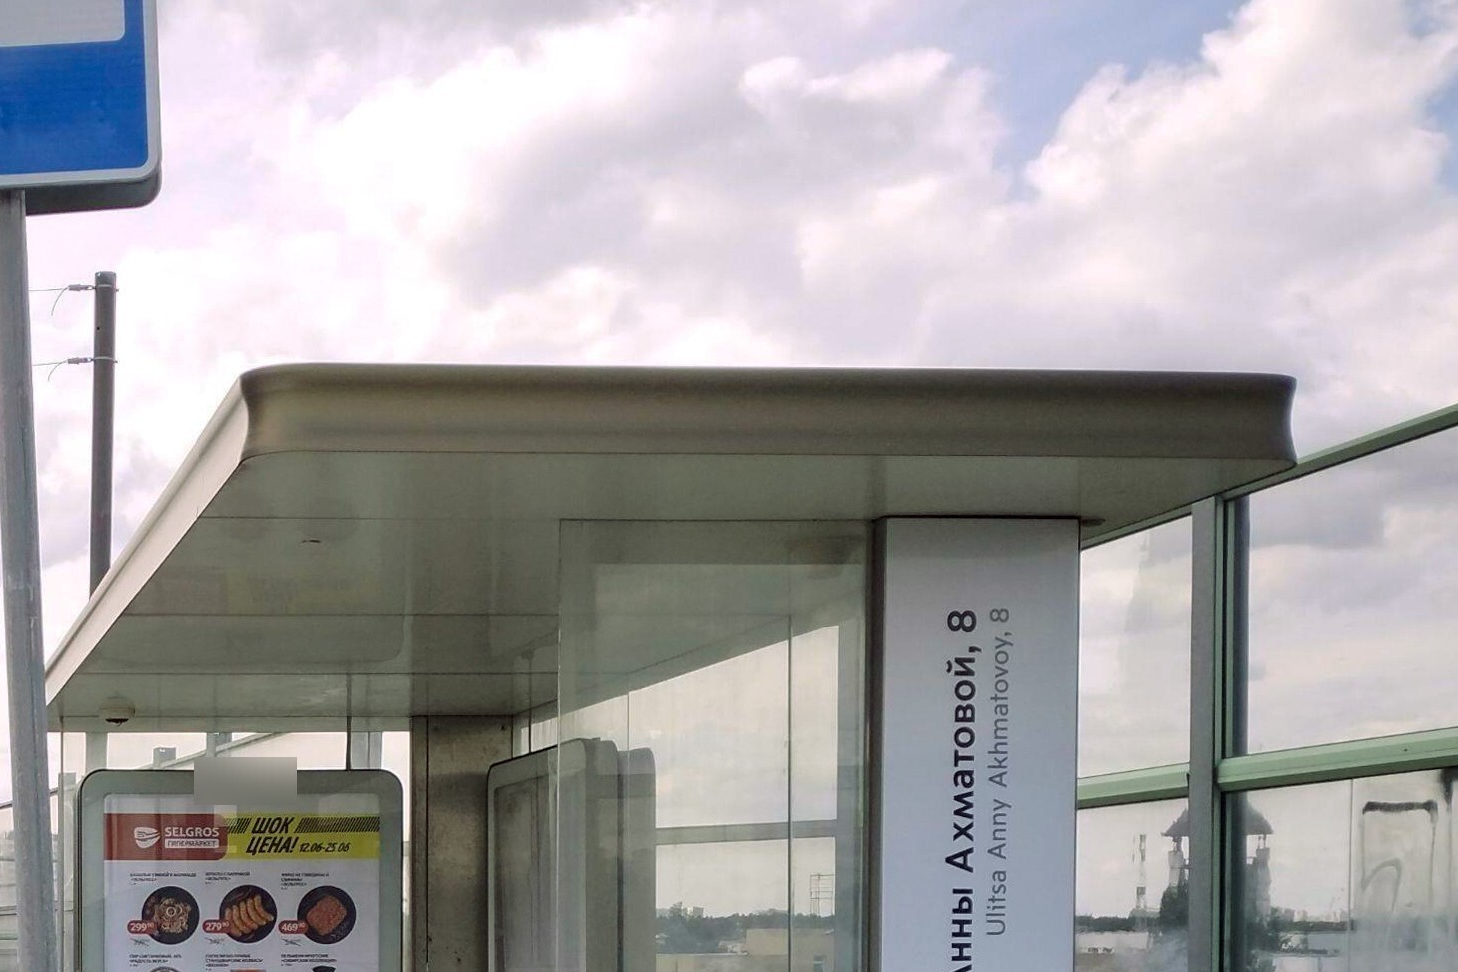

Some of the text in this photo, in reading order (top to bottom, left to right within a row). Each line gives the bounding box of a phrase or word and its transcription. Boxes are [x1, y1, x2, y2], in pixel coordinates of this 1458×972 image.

[947, 609, 978, 634] 8
[944, 646, 983, 873] Ахматовой,
[986, 608, 1014, 936] Ulitsa Anny Akhmatovoy, 8
[165, 827, 220, 837] SELGROS
[251, 817, 295, 834] ШОК
[246, 836, 299, 855] ЦЕНА!
